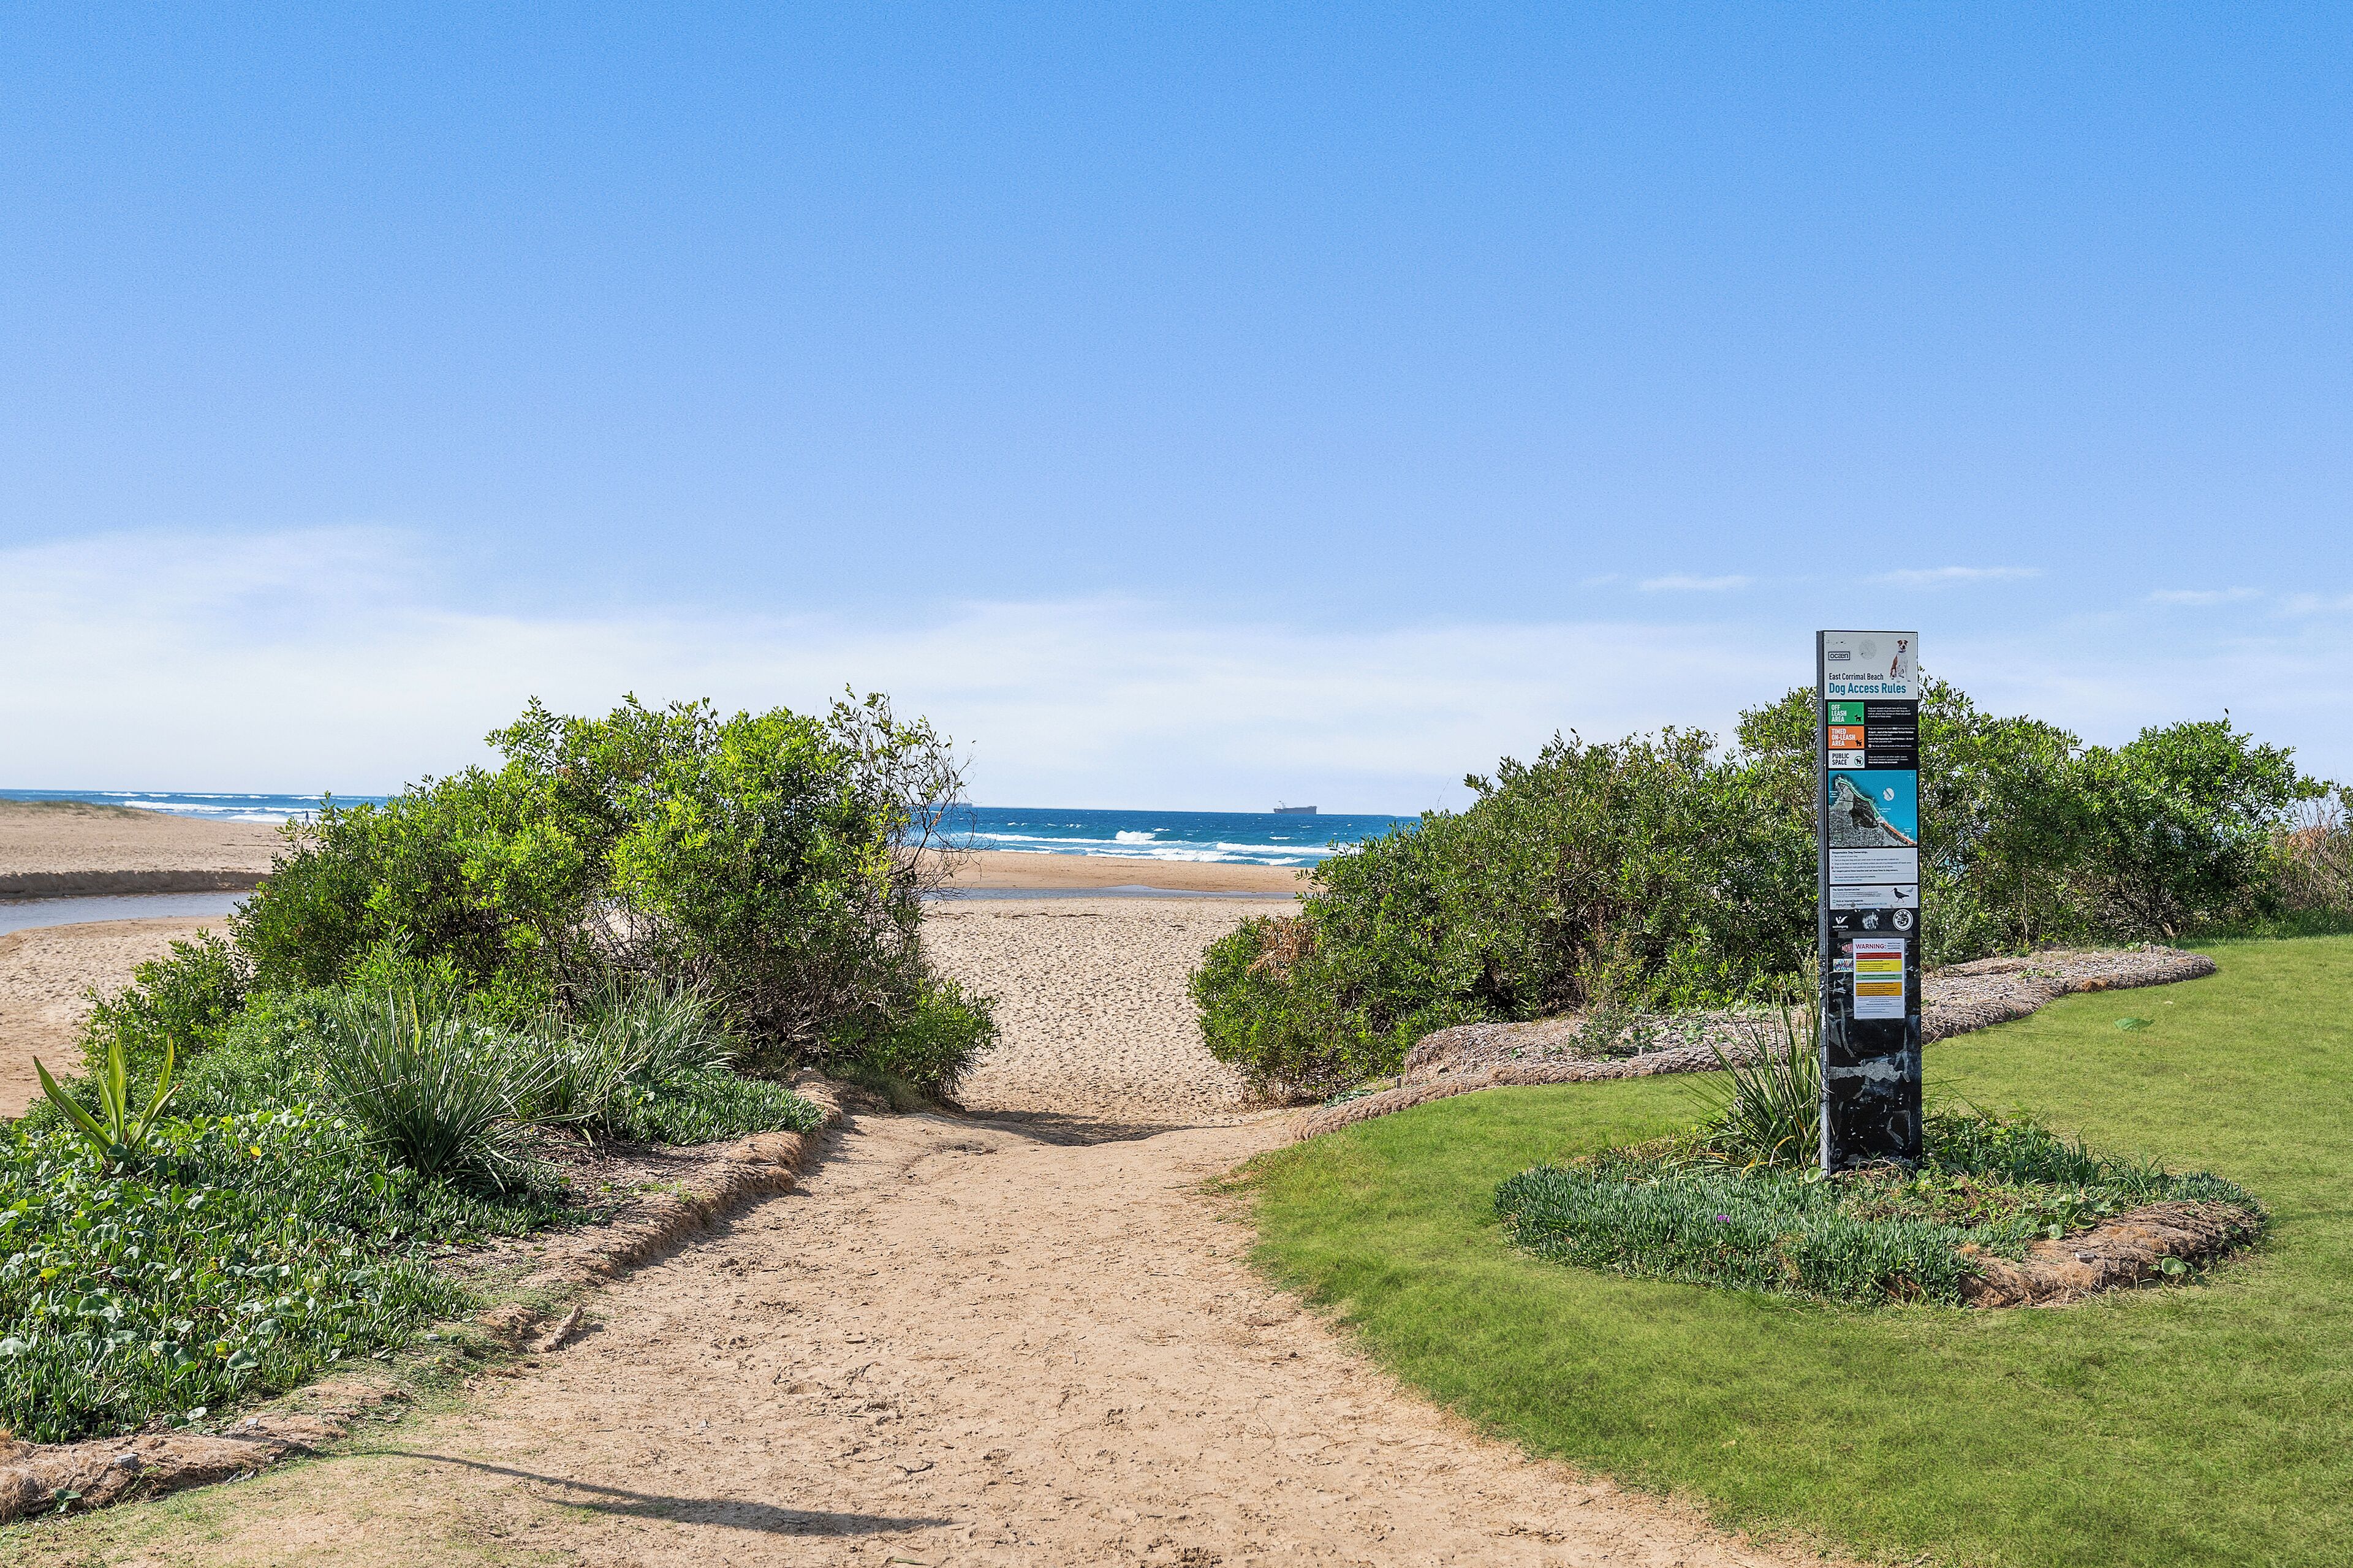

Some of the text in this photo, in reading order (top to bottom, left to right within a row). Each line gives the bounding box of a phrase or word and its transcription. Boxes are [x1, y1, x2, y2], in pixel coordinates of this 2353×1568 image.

[1829, 683, 1906, 696] Dog Access Rules
